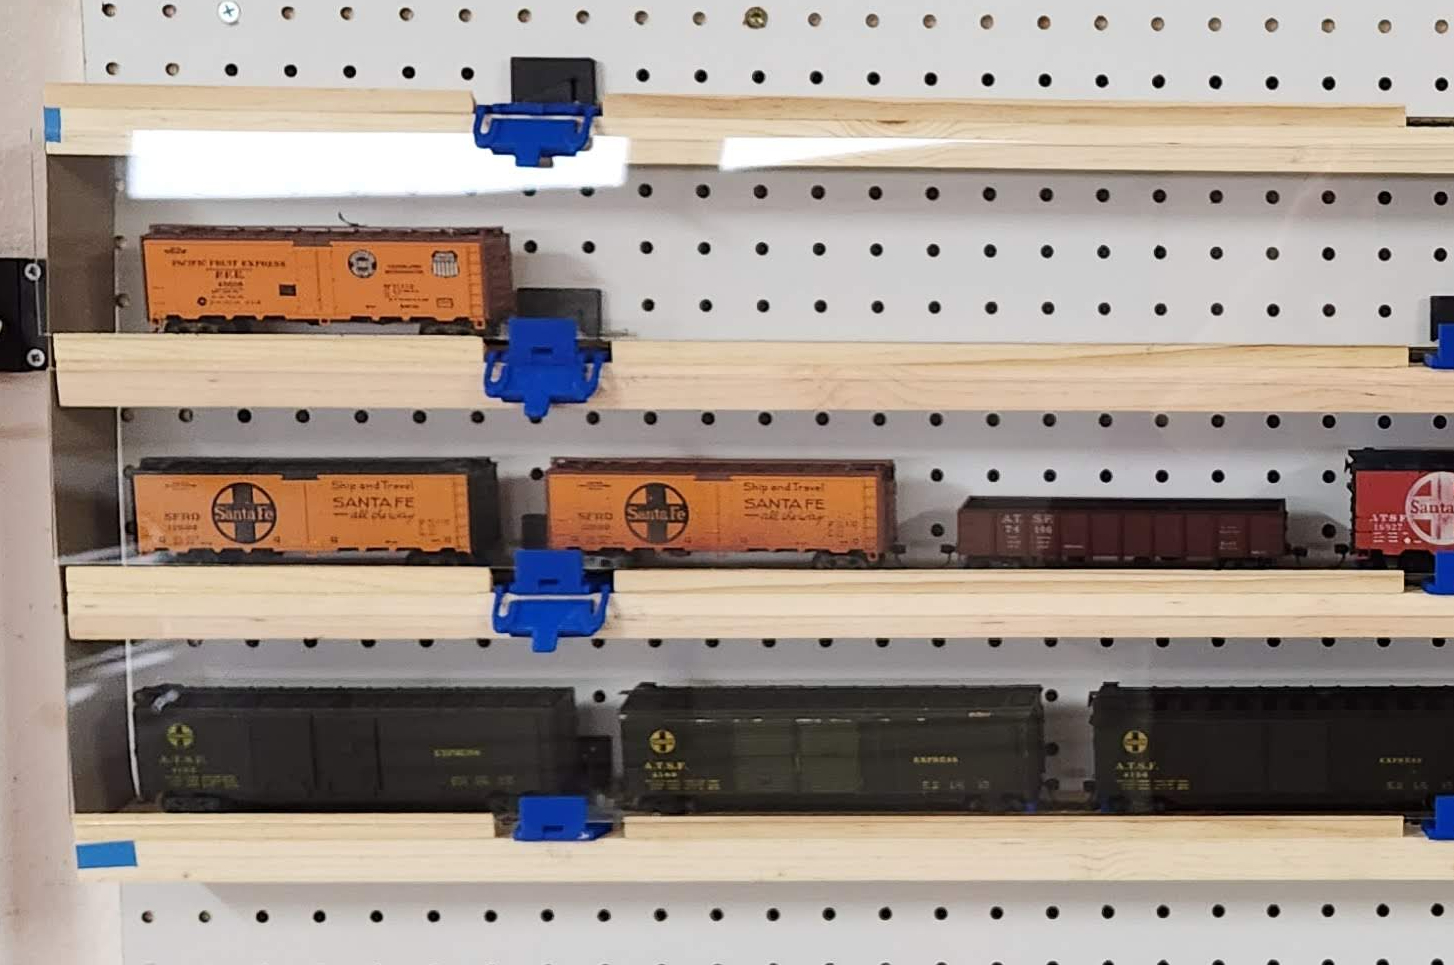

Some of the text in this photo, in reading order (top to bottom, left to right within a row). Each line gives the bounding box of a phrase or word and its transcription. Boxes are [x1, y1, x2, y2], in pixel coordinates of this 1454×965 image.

[743, 482, 769, 494] Ship
[771, 482, 791, 491] and
[333, 496, 415, 508] SANTA FE
[744, 498, 826, 510] SANTA FE
[1410, 500, 1454, 514] Santa
[214, 505, 275, 520] Santa Fe
[626, 505, 687, 520] Santa Fe
